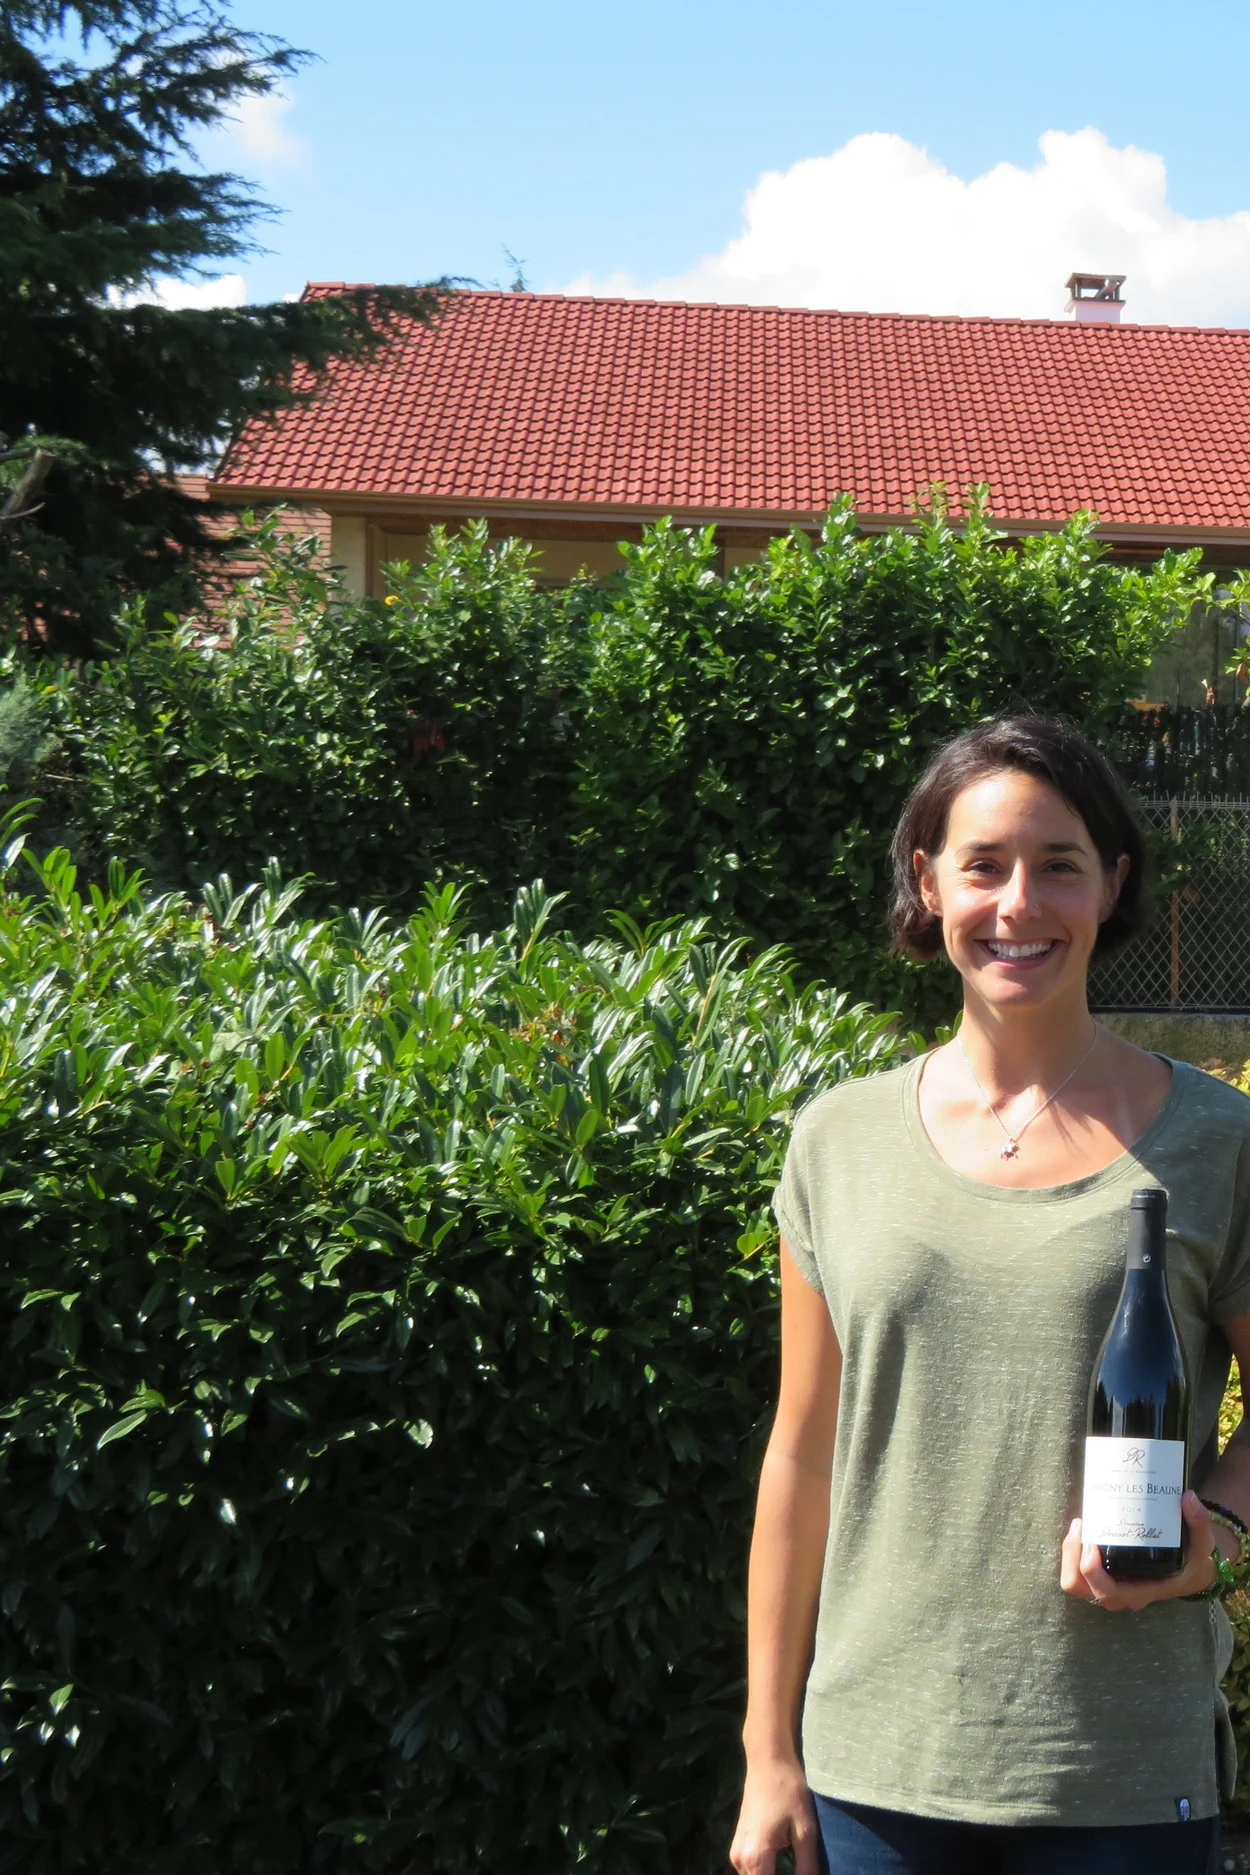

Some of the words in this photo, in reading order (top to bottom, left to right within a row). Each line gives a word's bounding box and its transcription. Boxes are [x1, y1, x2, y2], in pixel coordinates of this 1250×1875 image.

[1090, 1483, 1123, 1494] VIGNY
[1126, 1484, 1143, 1494] LES
[1147, 1482, 1181, 1495] BEAUNE
